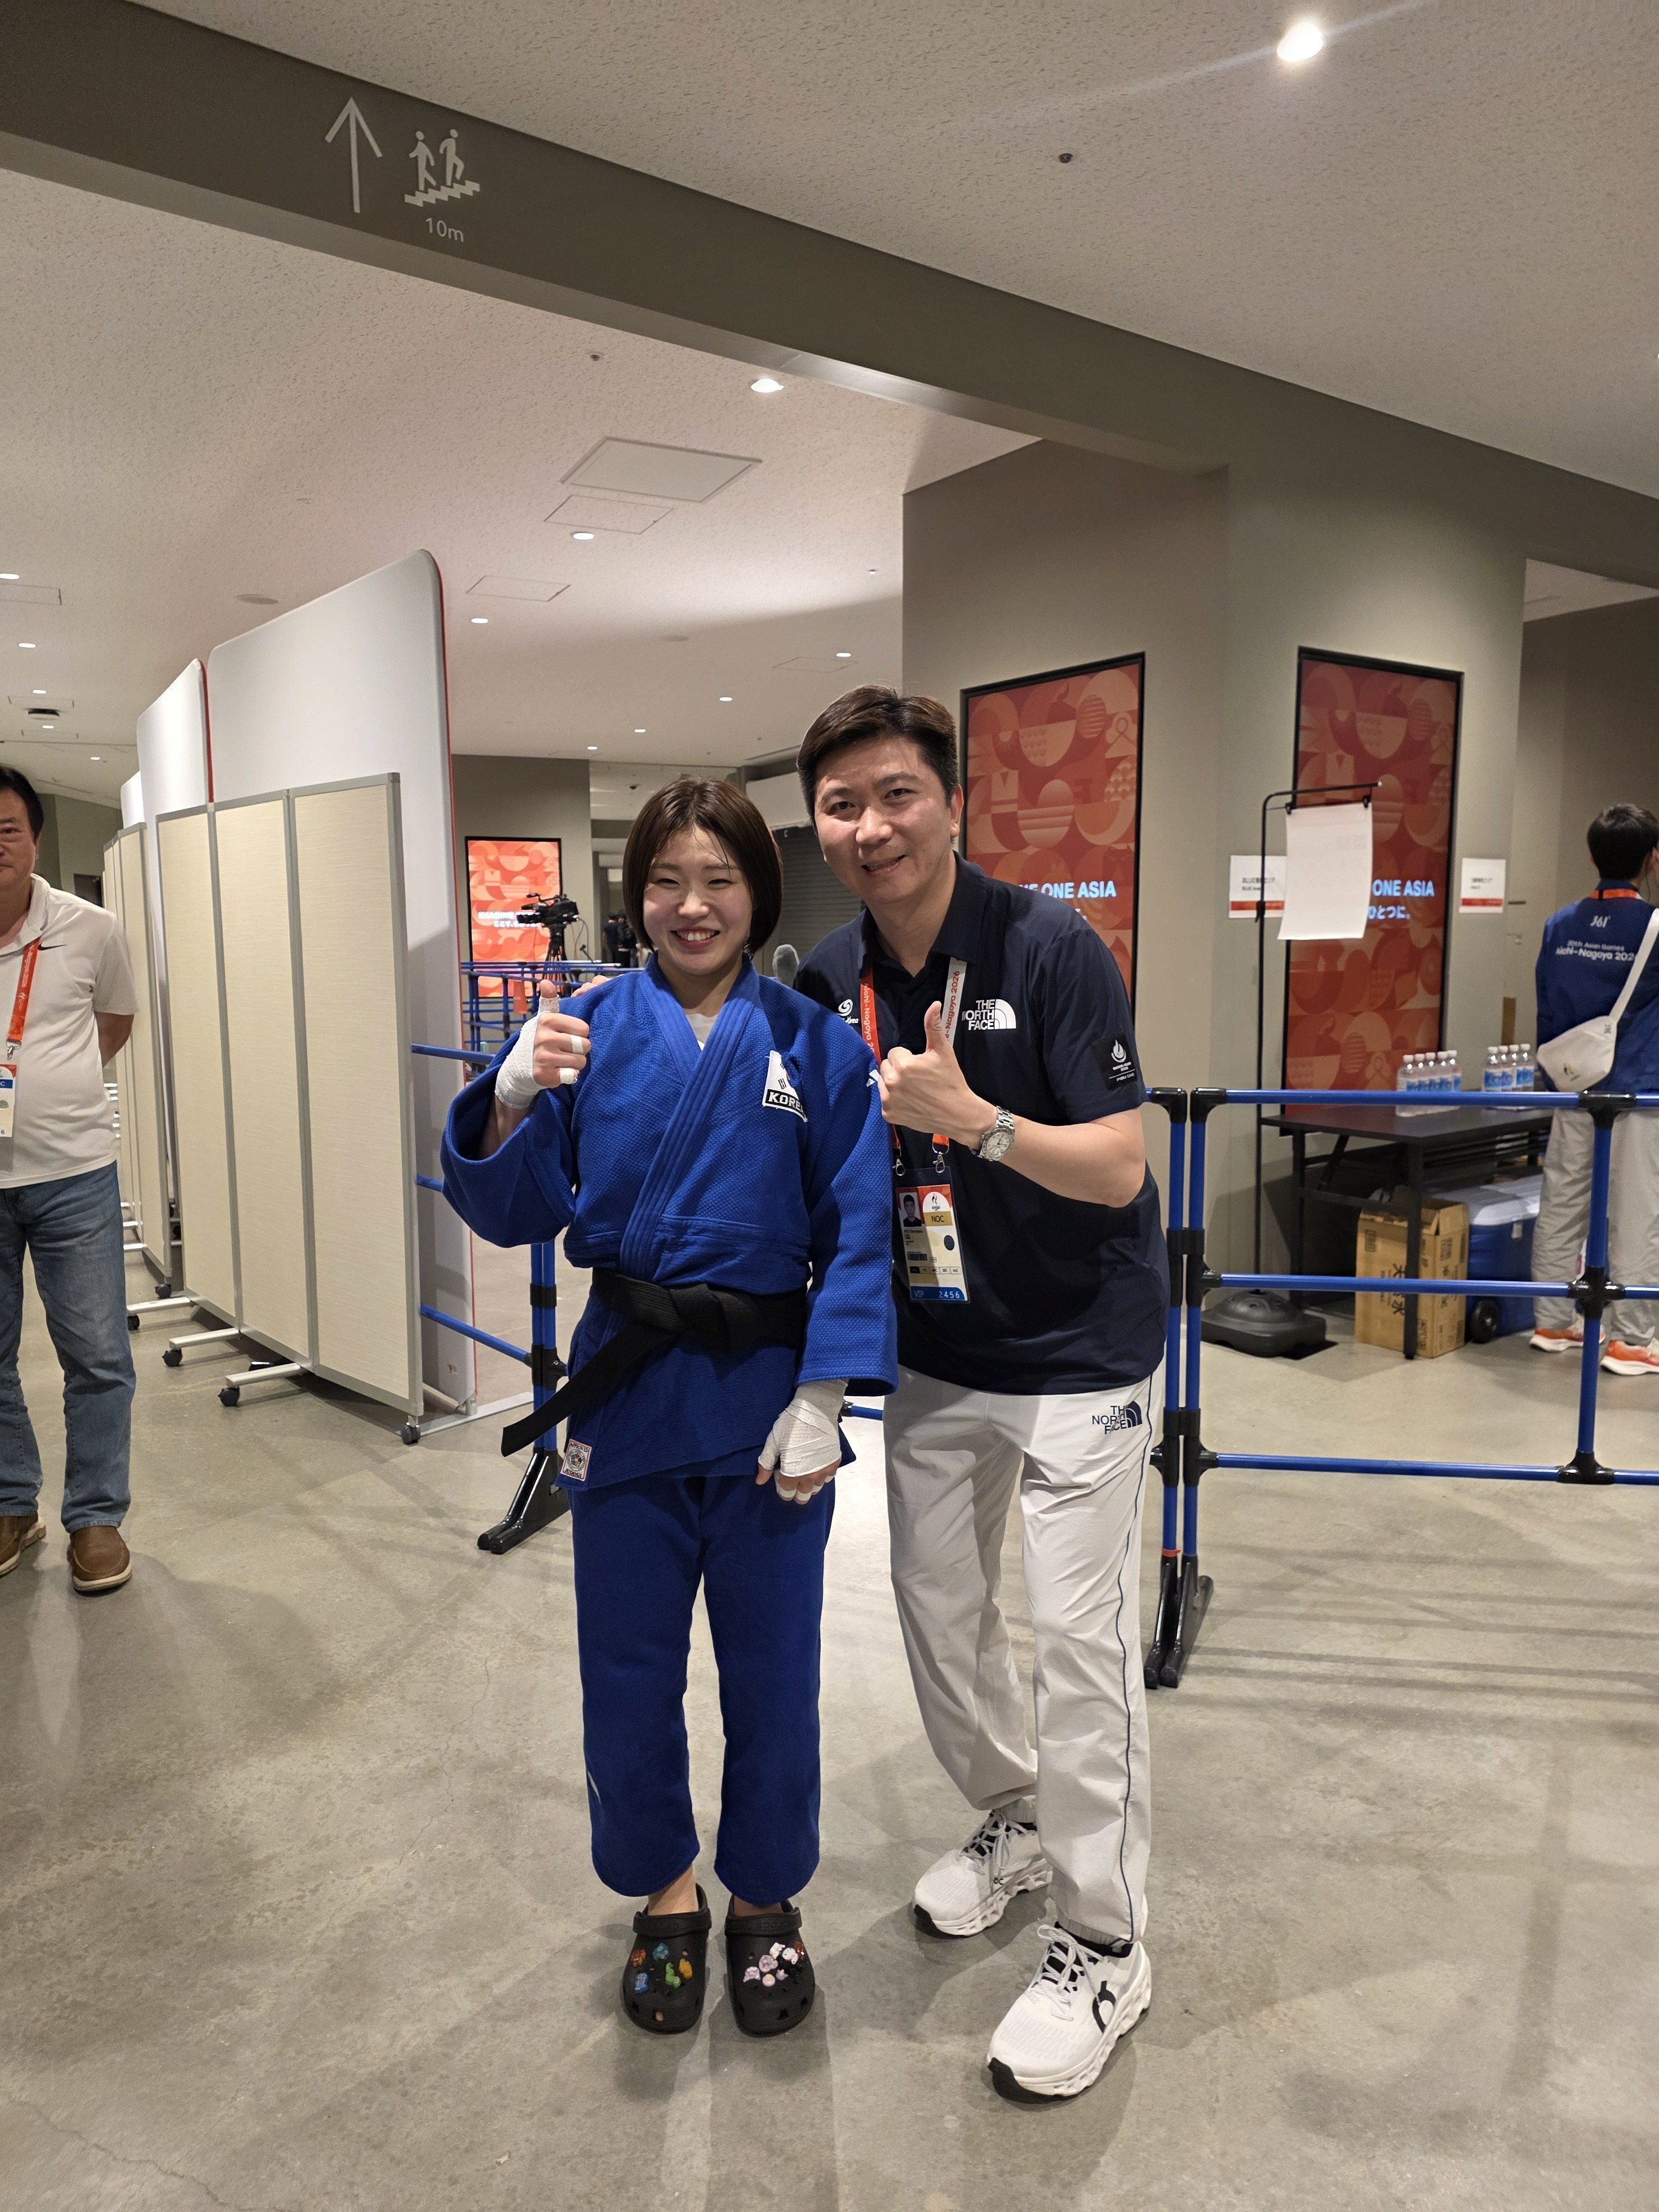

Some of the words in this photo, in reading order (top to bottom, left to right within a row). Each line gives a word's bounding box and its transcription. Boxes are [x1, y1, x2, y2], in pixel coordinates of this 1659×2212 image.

[425, 217, 464, 242] 10m
[1041, 883, 1074, 899] ONE
[1077, 880, 1117, 898] ASIA
[1372, 879, 1402, 896] ONE
[1403, 879, 1434, 897] ASIA
[951, 971, 959, 994] 2026
[976, 999, 995, 1010] THE
[968, 1019, 994, 1031] FACE
